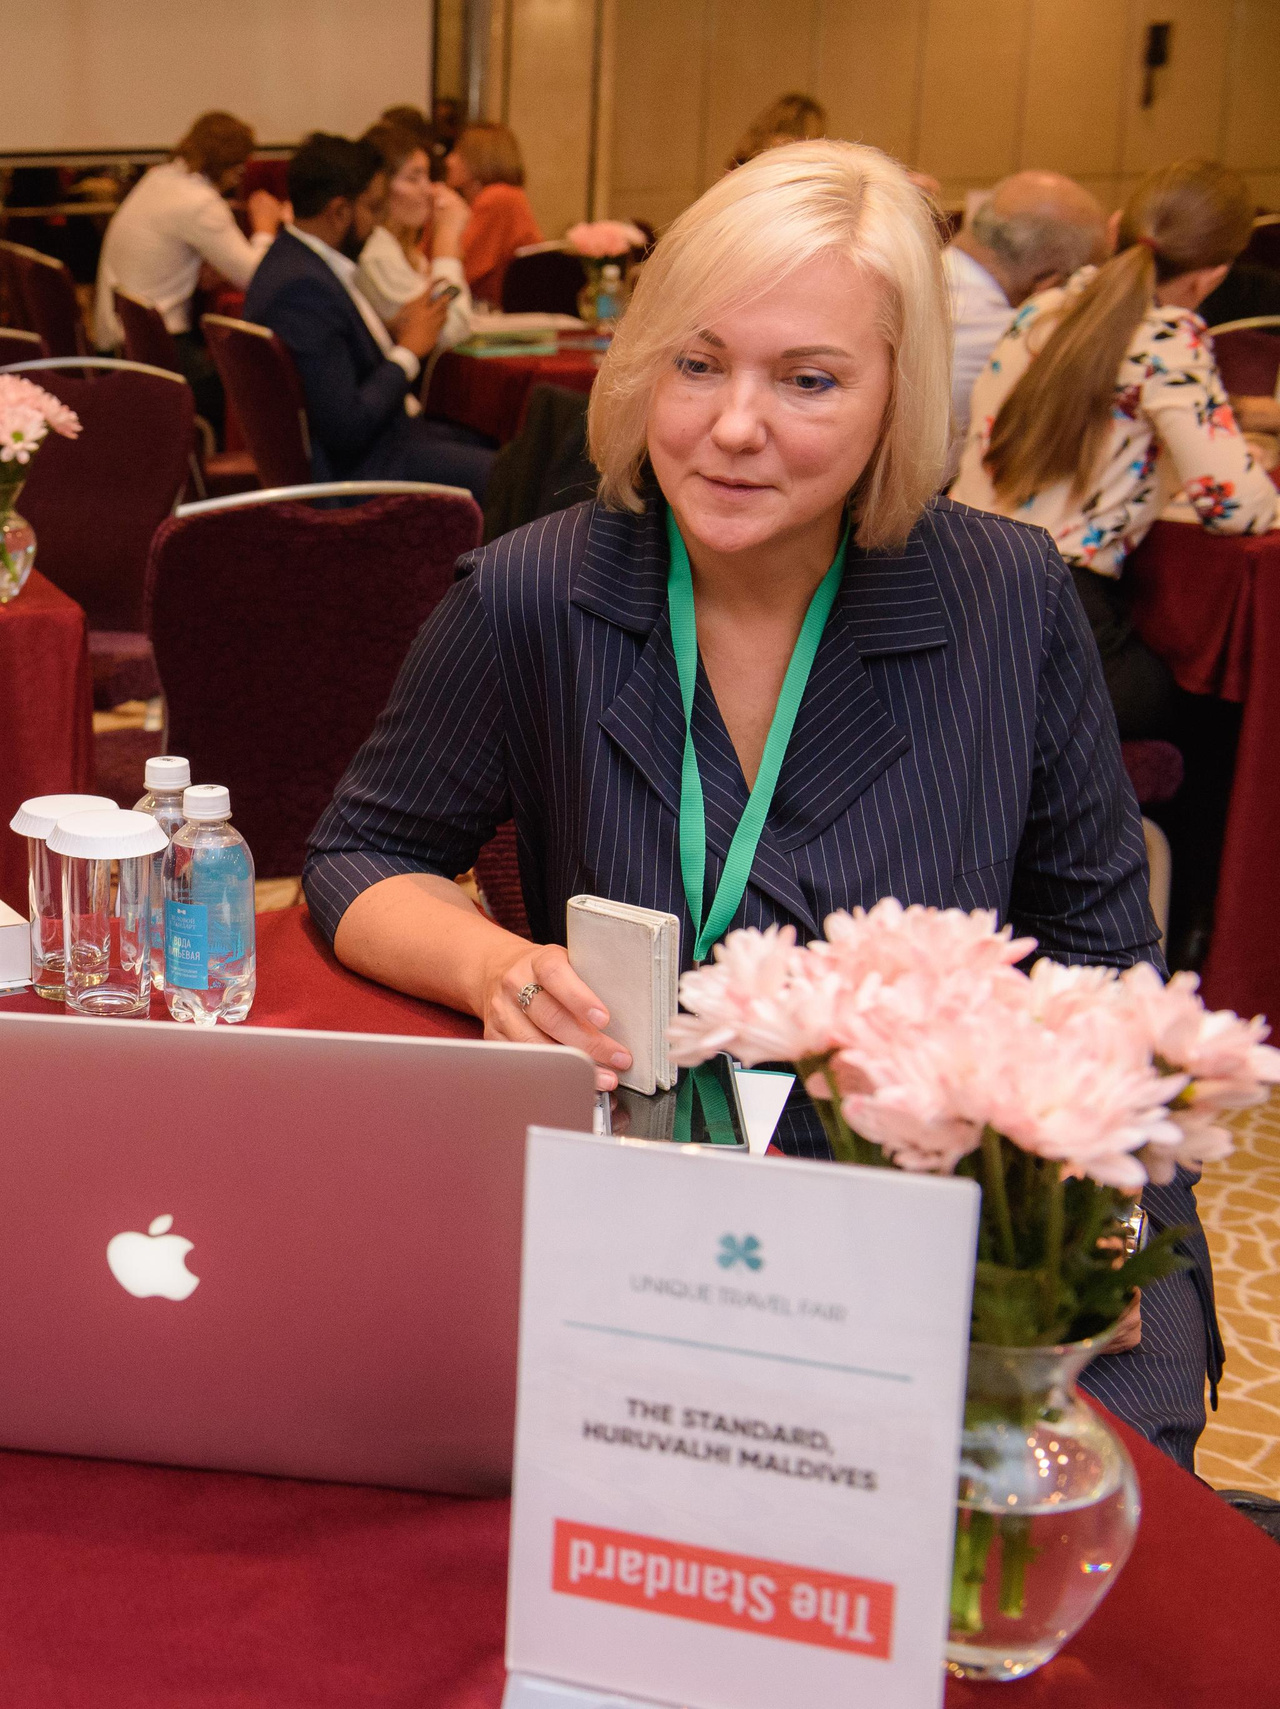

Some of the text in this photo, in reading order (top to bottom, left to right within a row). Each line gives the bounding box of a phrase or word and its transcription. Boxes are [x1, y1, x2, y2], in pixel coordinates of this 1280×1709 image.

[173, 935, 192, 949] ВОДА
[629, 1274, 848, 1323] UNIQUE TRAVEL FAIR
[581, 1420, 878, 1492] HURUVALHI MALDIVES
[626, 1397, 834, 1456] THE STANDARD,
[568, 1537, 876, 1645] The Standard
